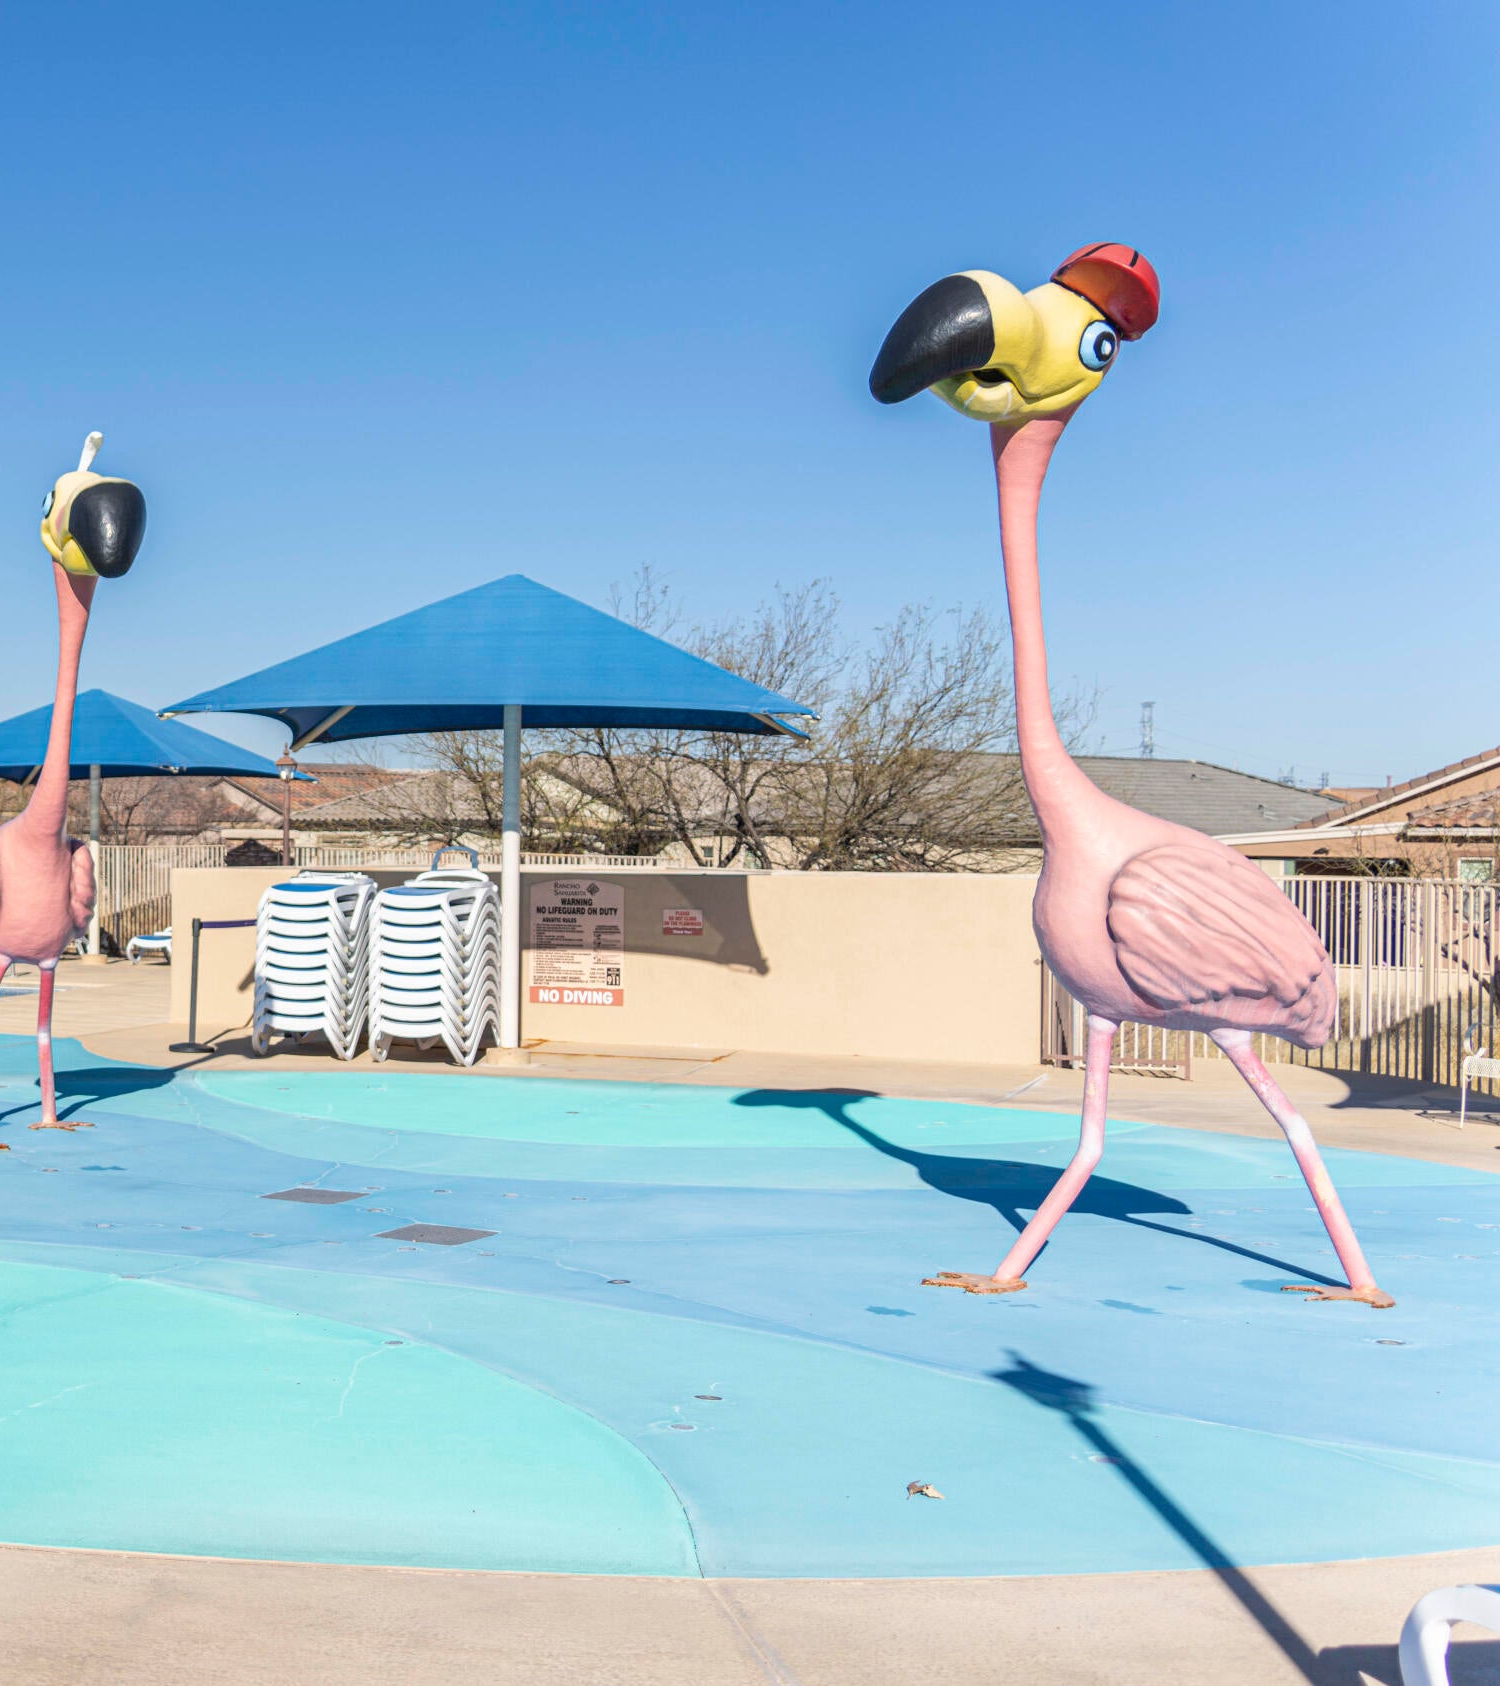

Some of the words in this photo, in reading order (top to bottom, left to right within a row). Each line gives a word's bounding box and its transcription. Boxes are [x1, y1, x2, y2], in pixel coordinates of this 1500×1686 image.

[561, 898, 593, 906] WARNING
[536, 906, 546, 914] NO
[548, 906, 586, 914] LIFEGUARD
[587, 907, 598, 915] ON
[599, 908, 618, 916] DUTY
[607, 975, 620, 985] 911
[539, 989, 560, 1002] NO
[563, 990, 613, 1005] DIVING
